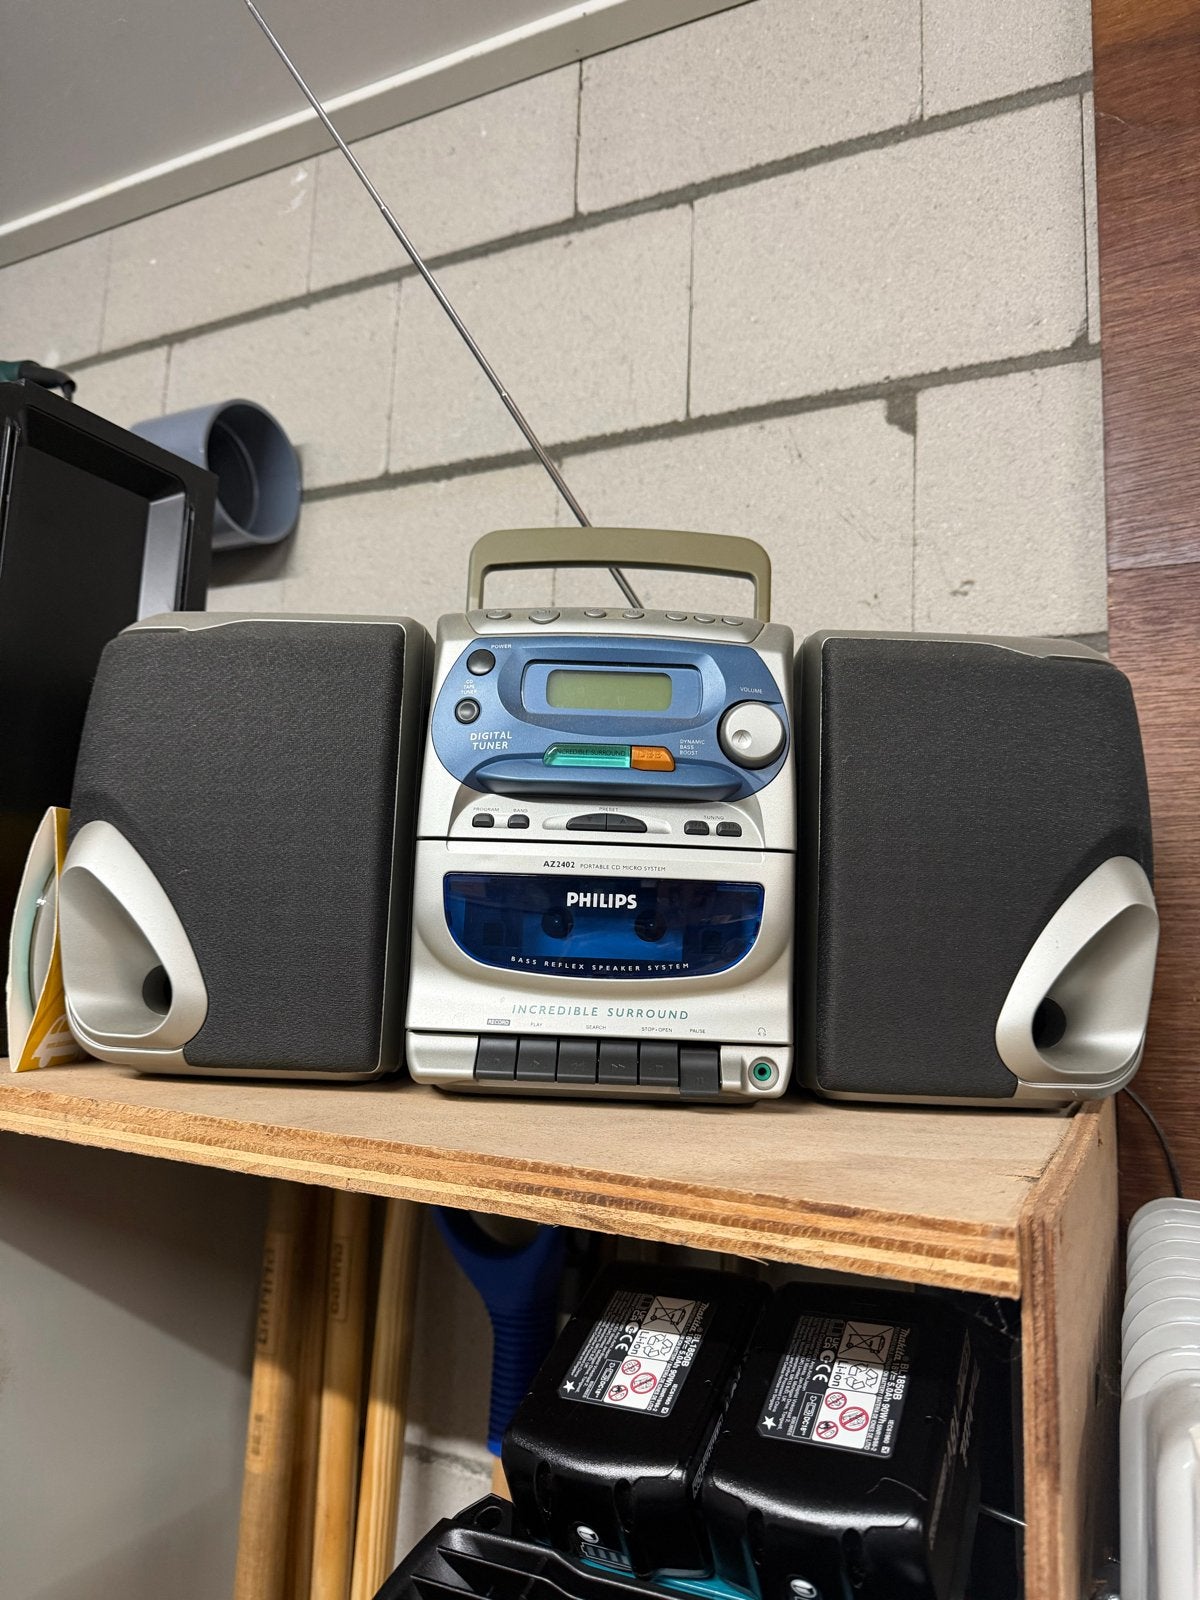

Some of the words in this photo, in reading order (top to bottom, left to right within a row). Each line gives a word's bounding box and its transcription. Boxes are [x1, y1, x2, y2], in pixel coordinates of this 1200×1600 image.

[740, 686, 763, 695] VOLUME
[470, 731, 513, 741] DIGITAL
[472, 741, 509, 750] TUNER
[543, 860, 575, 869] AZ2402
[566, 891, 638, 910] PHILIPS
[510, 955, 537, 966] BASS
[544, 960, 585, 970] REFLEX
[591, 964, 641, 972] SPEAKER
[647, 962, 690, 971] SYSTEM
[511, 1004, 599, 1017] INCREDIBLE
[607, 1007, 689, 1020] SURROUND
[630, 1330, 650, 1355] Li-ion
[680, 1333, 702, 1367] BL1850B
[671, 1349, 686, 1369] 5.0Ah
[662, 1368, 678, 1388] 90Wh
[829, 1359, 848, 1387] Li-ion
[891, 1362, 909, 1401] BL1850B
[882, 1380, 895, 1402] 5.0Ah
[877, 1402, 890, 1424] 90Wh
